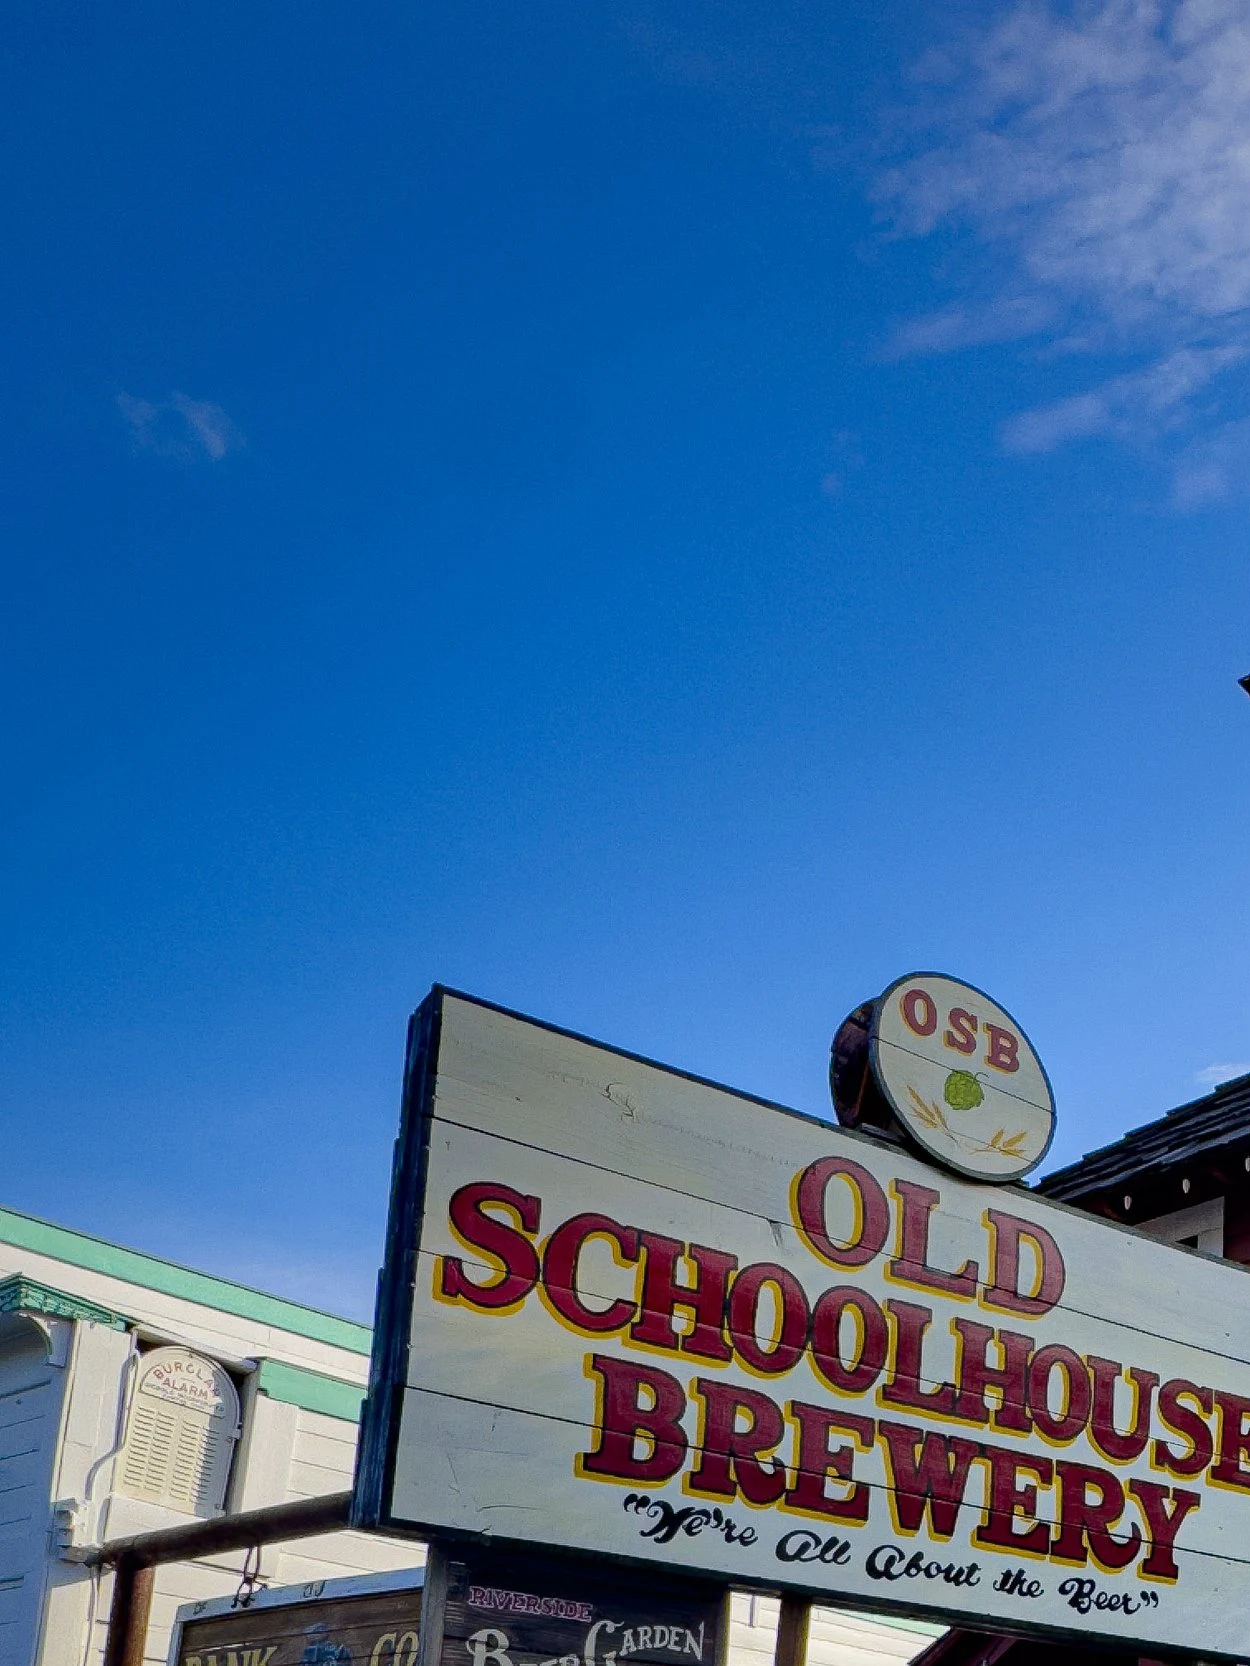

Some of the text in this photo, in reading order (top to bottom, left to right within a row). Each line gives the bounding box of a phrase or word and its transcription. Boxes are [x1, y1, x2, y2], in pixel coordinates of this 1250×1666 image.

[901, 989, 1020, 1073] OSB
[789, 1156, 1066, 1320] OLD
[163, 1378, 209, 1400] ALARM
[574, 1353, 1201, 1584] BREWERY
[775, 1529, 851, 1565] All
[865, 1544, 981, 1587] About
[993, 1568, 1044, 1598] the
[469, 1586, 593, 1622] RIVERSIDE
